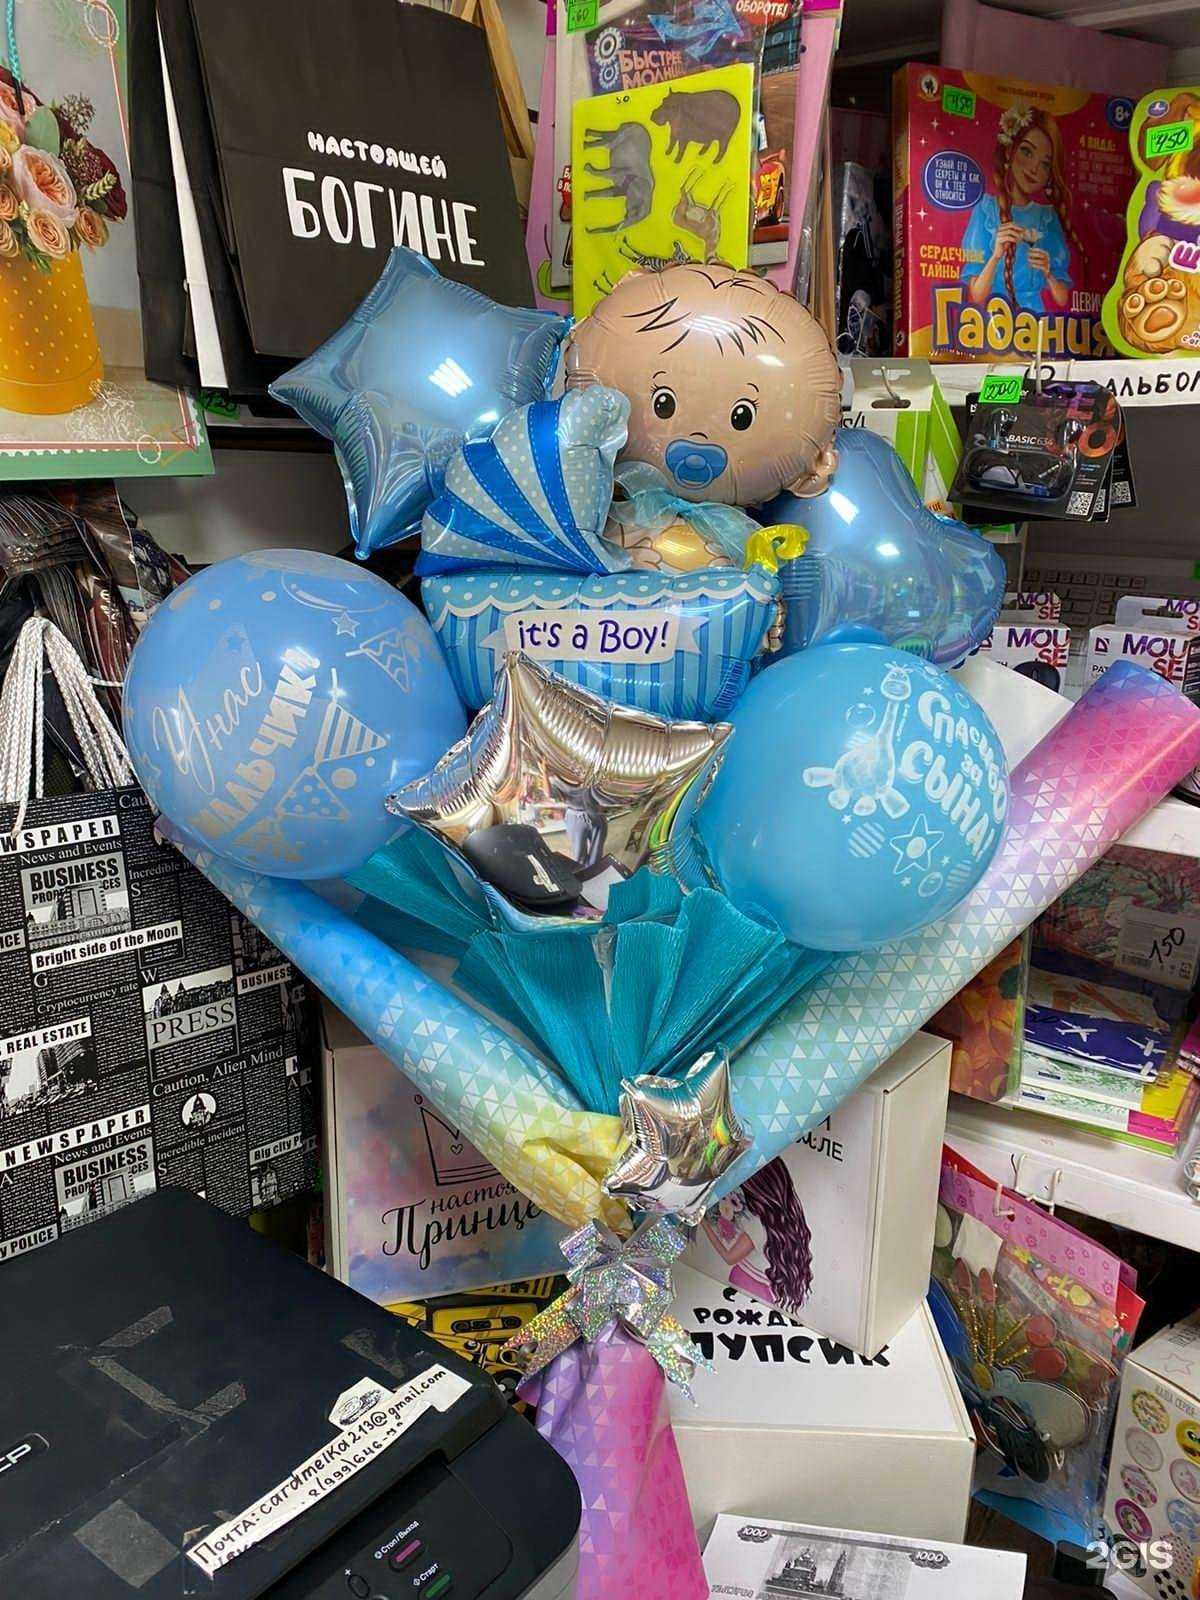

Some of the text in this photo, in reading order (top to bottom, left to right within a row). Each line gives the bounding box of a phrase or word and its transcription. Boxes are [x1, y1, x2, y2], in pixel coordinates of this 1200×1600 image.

[735, 0, 788, 17] ОБОРОТЕ!
[1115, 105, 1132, 121] 8+
[307, 131, 448, 180] НАСТОЯЩЕЙ
[281, 167, 486, 266] БОГИНЕ
[919, 262, 961, 279] ТАЙНЫ
[1008, 434, 1037, 446] BASIC
[518, 619, 669, 655] it's a Boy!
[1007, 628, 1071, 648] MOU
[1122, 633, 1189, 658] MOU
[1038, 648, 1068, 668] SE
[20, 839, 122, 866] News and Events
[30, 858, 119, 892] BUSINESS
[36, 949, 78, 969] Bright
[80, 943, 107, 959] side
[110, 937, 122, 949] of
[124, 933, 145, 948] the
[147, 925, 179, 943] Moon
[1149, 927, 1186, 964] 150
[241, 965, 293, 990] BUSINESS
[37, 981, 139, 1015] Cryptocurrency rate
[6, 1021, 88, 1054] REAL ESTATE
[152, 1002, 235, 1045] PRESS
[152, 1074, 210, 1097] Caution,
[212, 1060, 248, 1079] Alien
[250, 1045, 284, 1066] Mind
[5, 1109, 146, 1167] NEWSPAPER
[54, 1127, 153, 1166] News and Events
[157, 1124, 247, 1161] Incredible incident
[63, 1144, 148, 1188] BUSINESS
[254, 1148, 272, 1162] Big
[10, 1227, 55, 1254] POLICE
[742, 1527, 768, 1538] 1000
[916, 1551, 944, 1564] 1000
